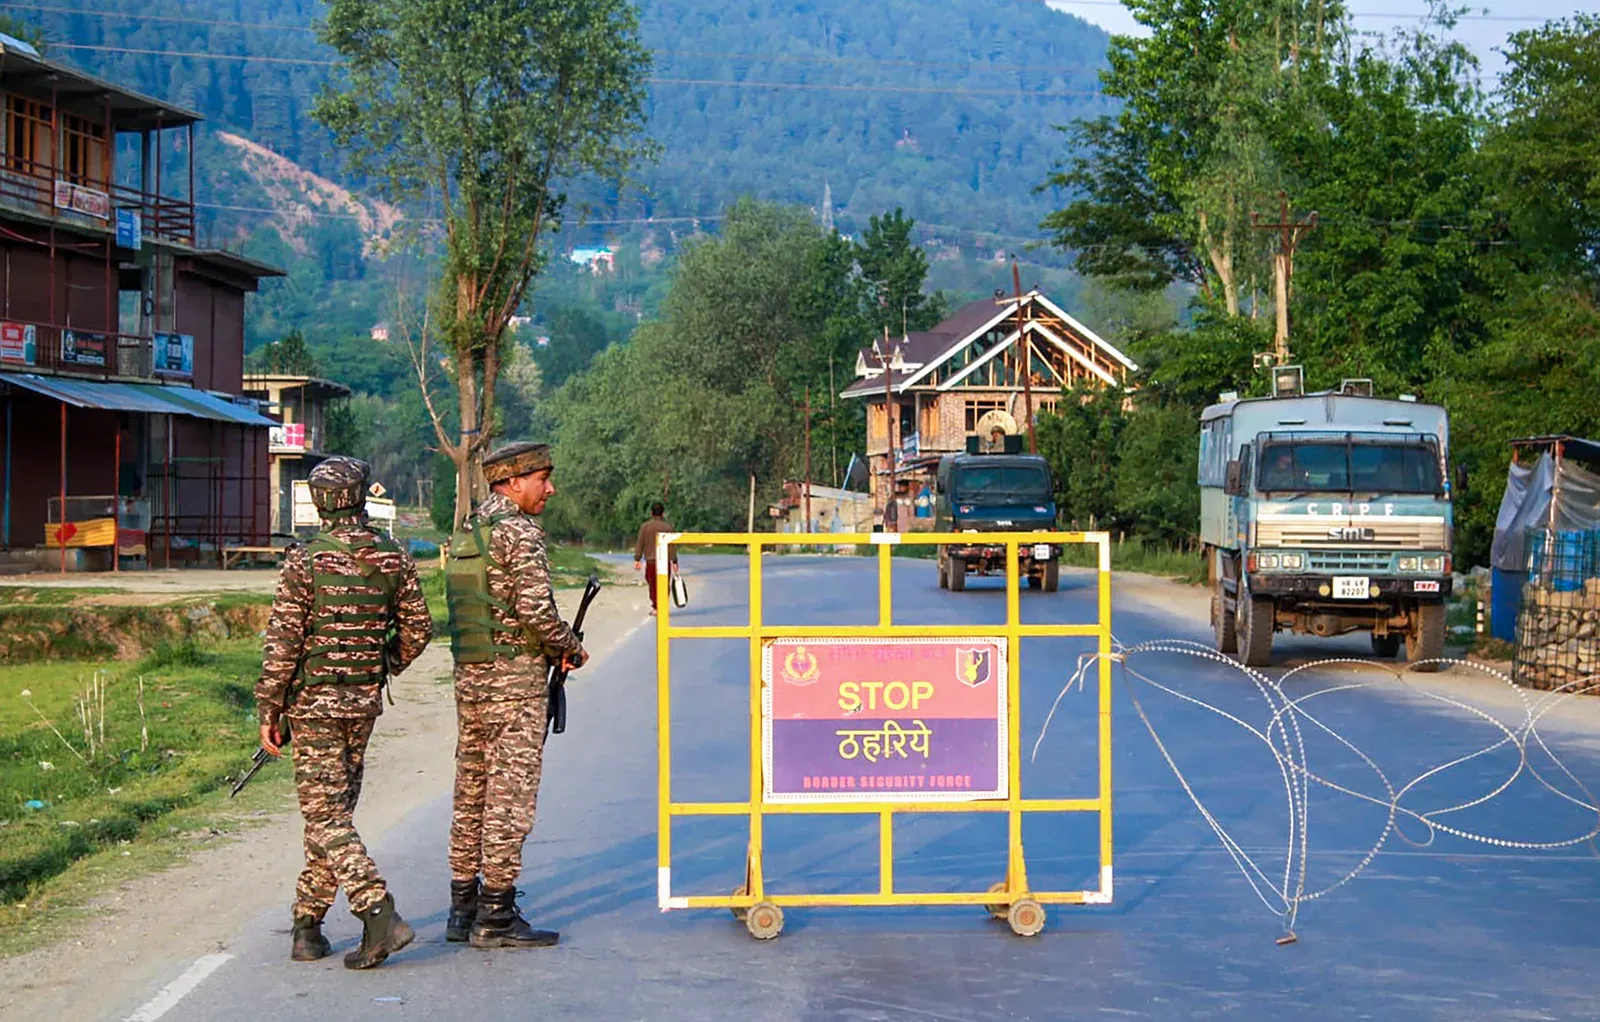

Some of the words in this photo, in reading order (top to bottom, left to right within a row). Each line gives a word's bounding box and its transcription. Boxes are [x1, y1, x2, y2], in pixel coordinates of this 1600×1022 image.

[838, 681, 934, 710] STOP
[836, 720, 932, 762] ठहरिये
[803, 776, 856, 788] BORDER
[860, 775, 924, 788] SECURITY
[929, 775, 971, 787] FORCE
